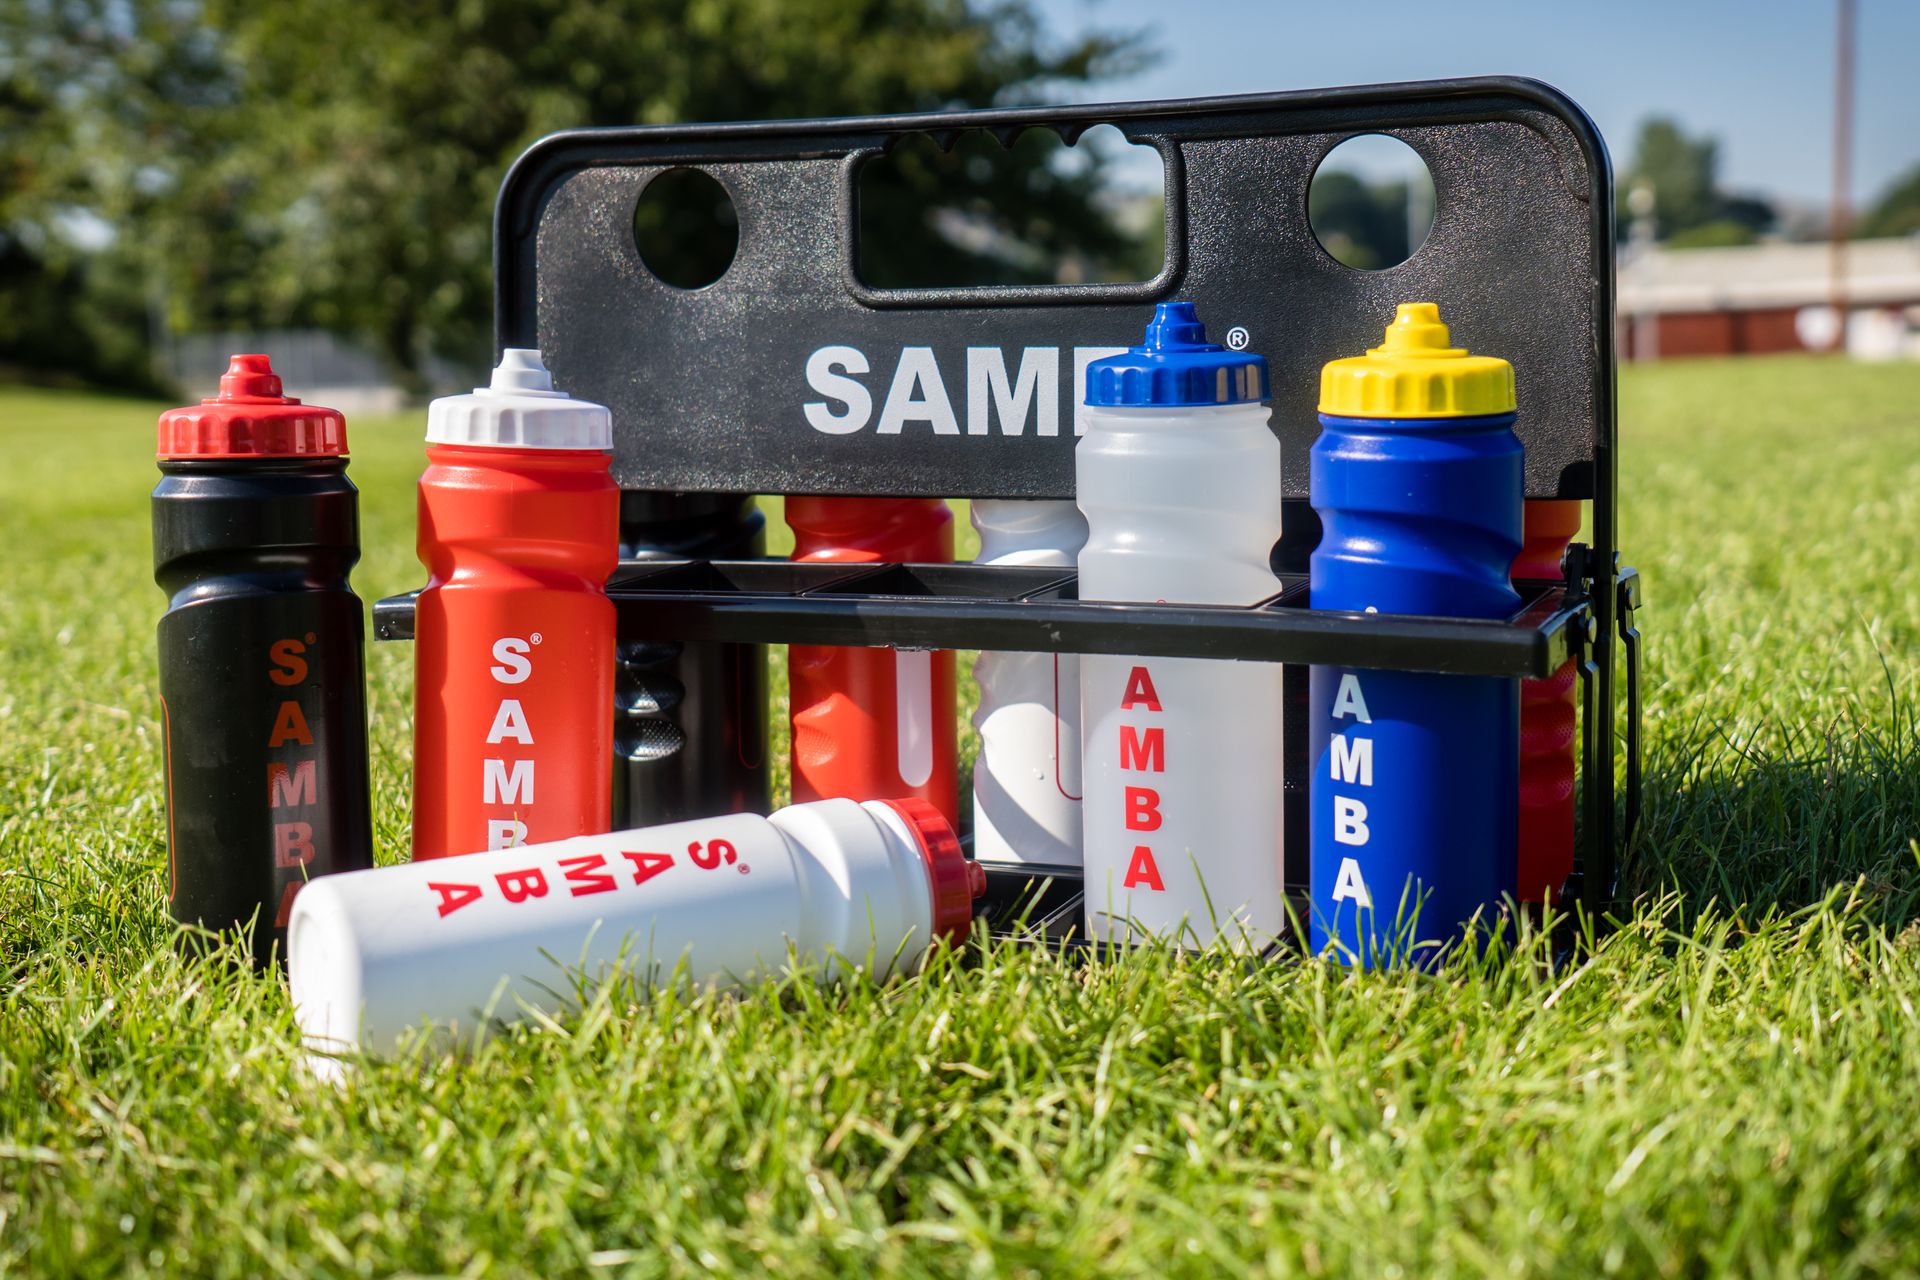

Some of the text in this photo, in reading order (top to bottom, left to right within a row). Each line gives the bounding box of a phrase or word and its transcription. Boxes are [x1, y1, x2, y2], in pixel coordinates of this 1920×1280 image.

[803, 345, 1129, 437] SAM
[483, 637, 535, 852] SAMB
[1119, 666, 1166, 892] AMBA
[1330, 673, 1374, 909] AMBA
[427, 838, 738, 919] SAMBA
